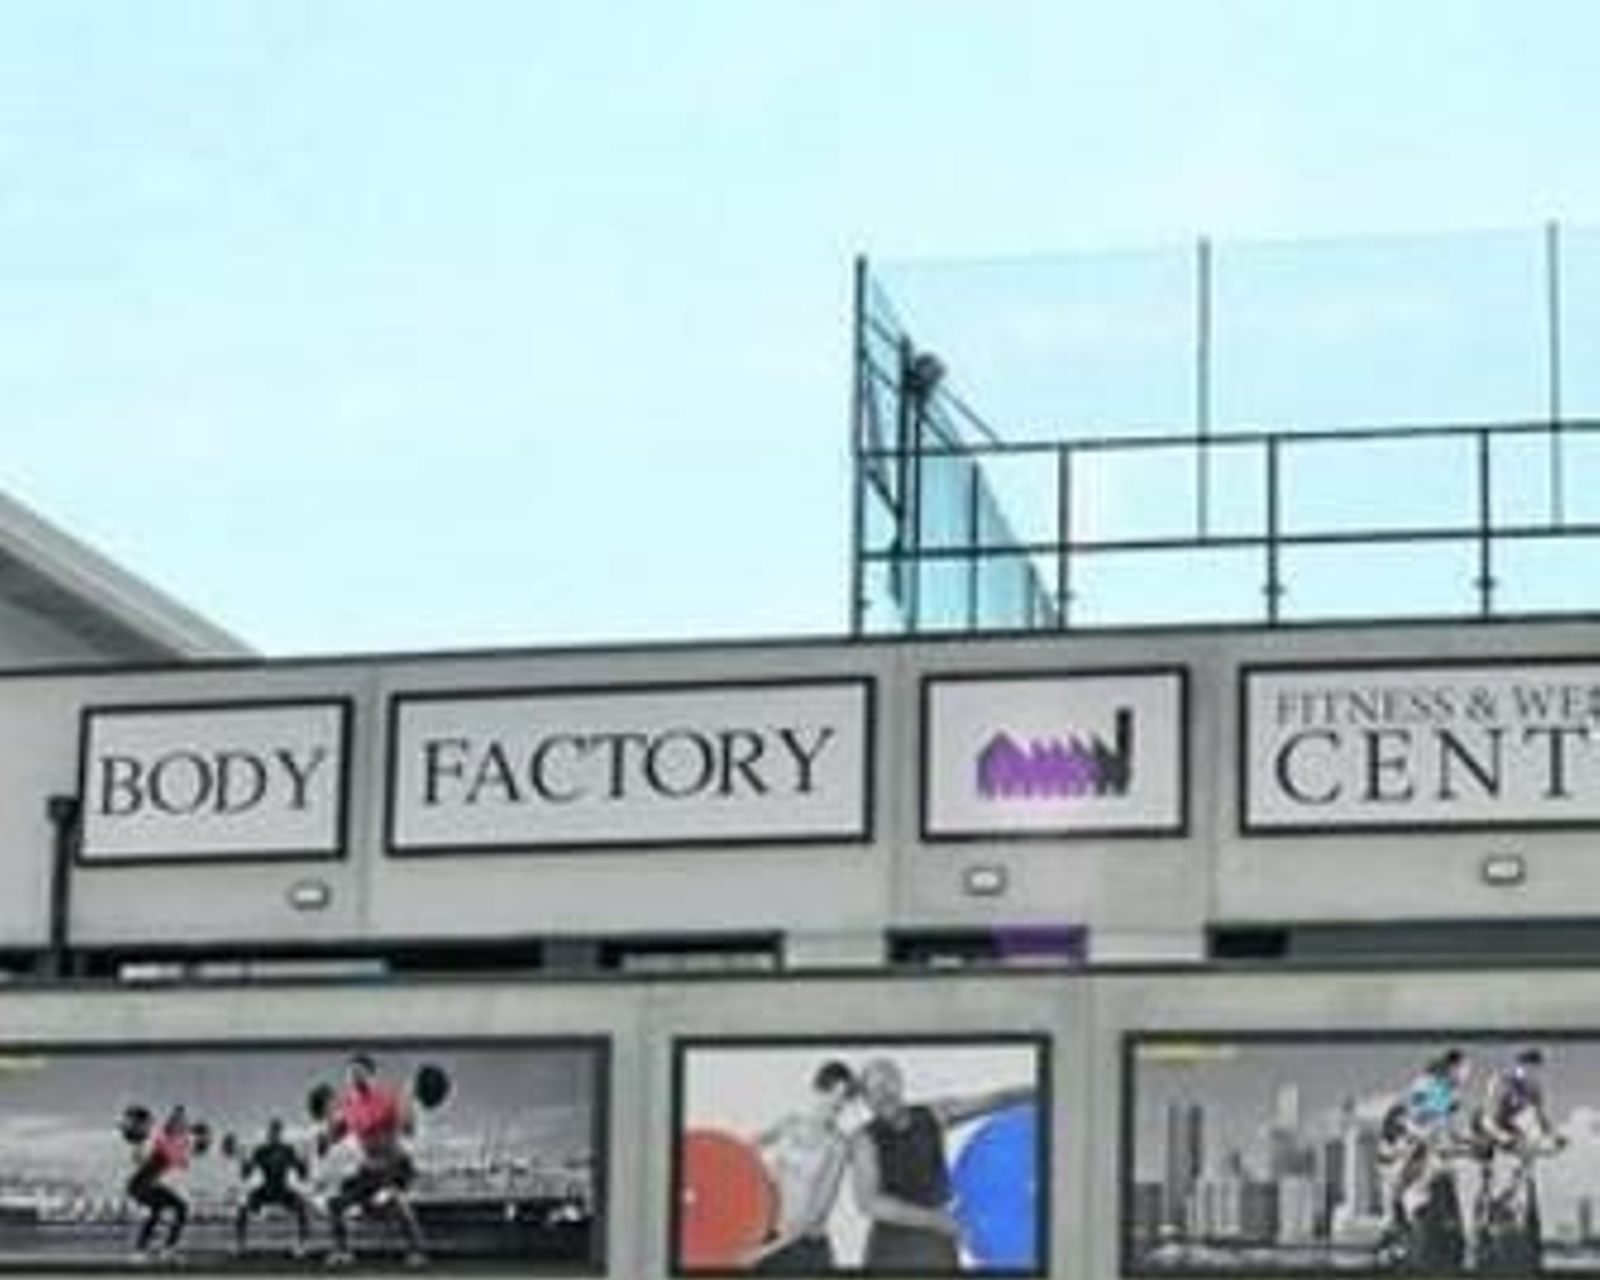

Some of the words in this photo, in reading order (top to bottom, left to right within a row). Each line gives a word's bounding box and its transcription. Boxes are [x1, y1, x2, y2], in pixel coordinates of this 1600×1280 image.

[1276, 687, 1454, 726] FITNESS
[1464, 686, 1498, 722] &
[100, 747, 325, 816] BODY
[422, 727, 834, 805] FACTORY
[1275, 727, 1589, 805] CENT
